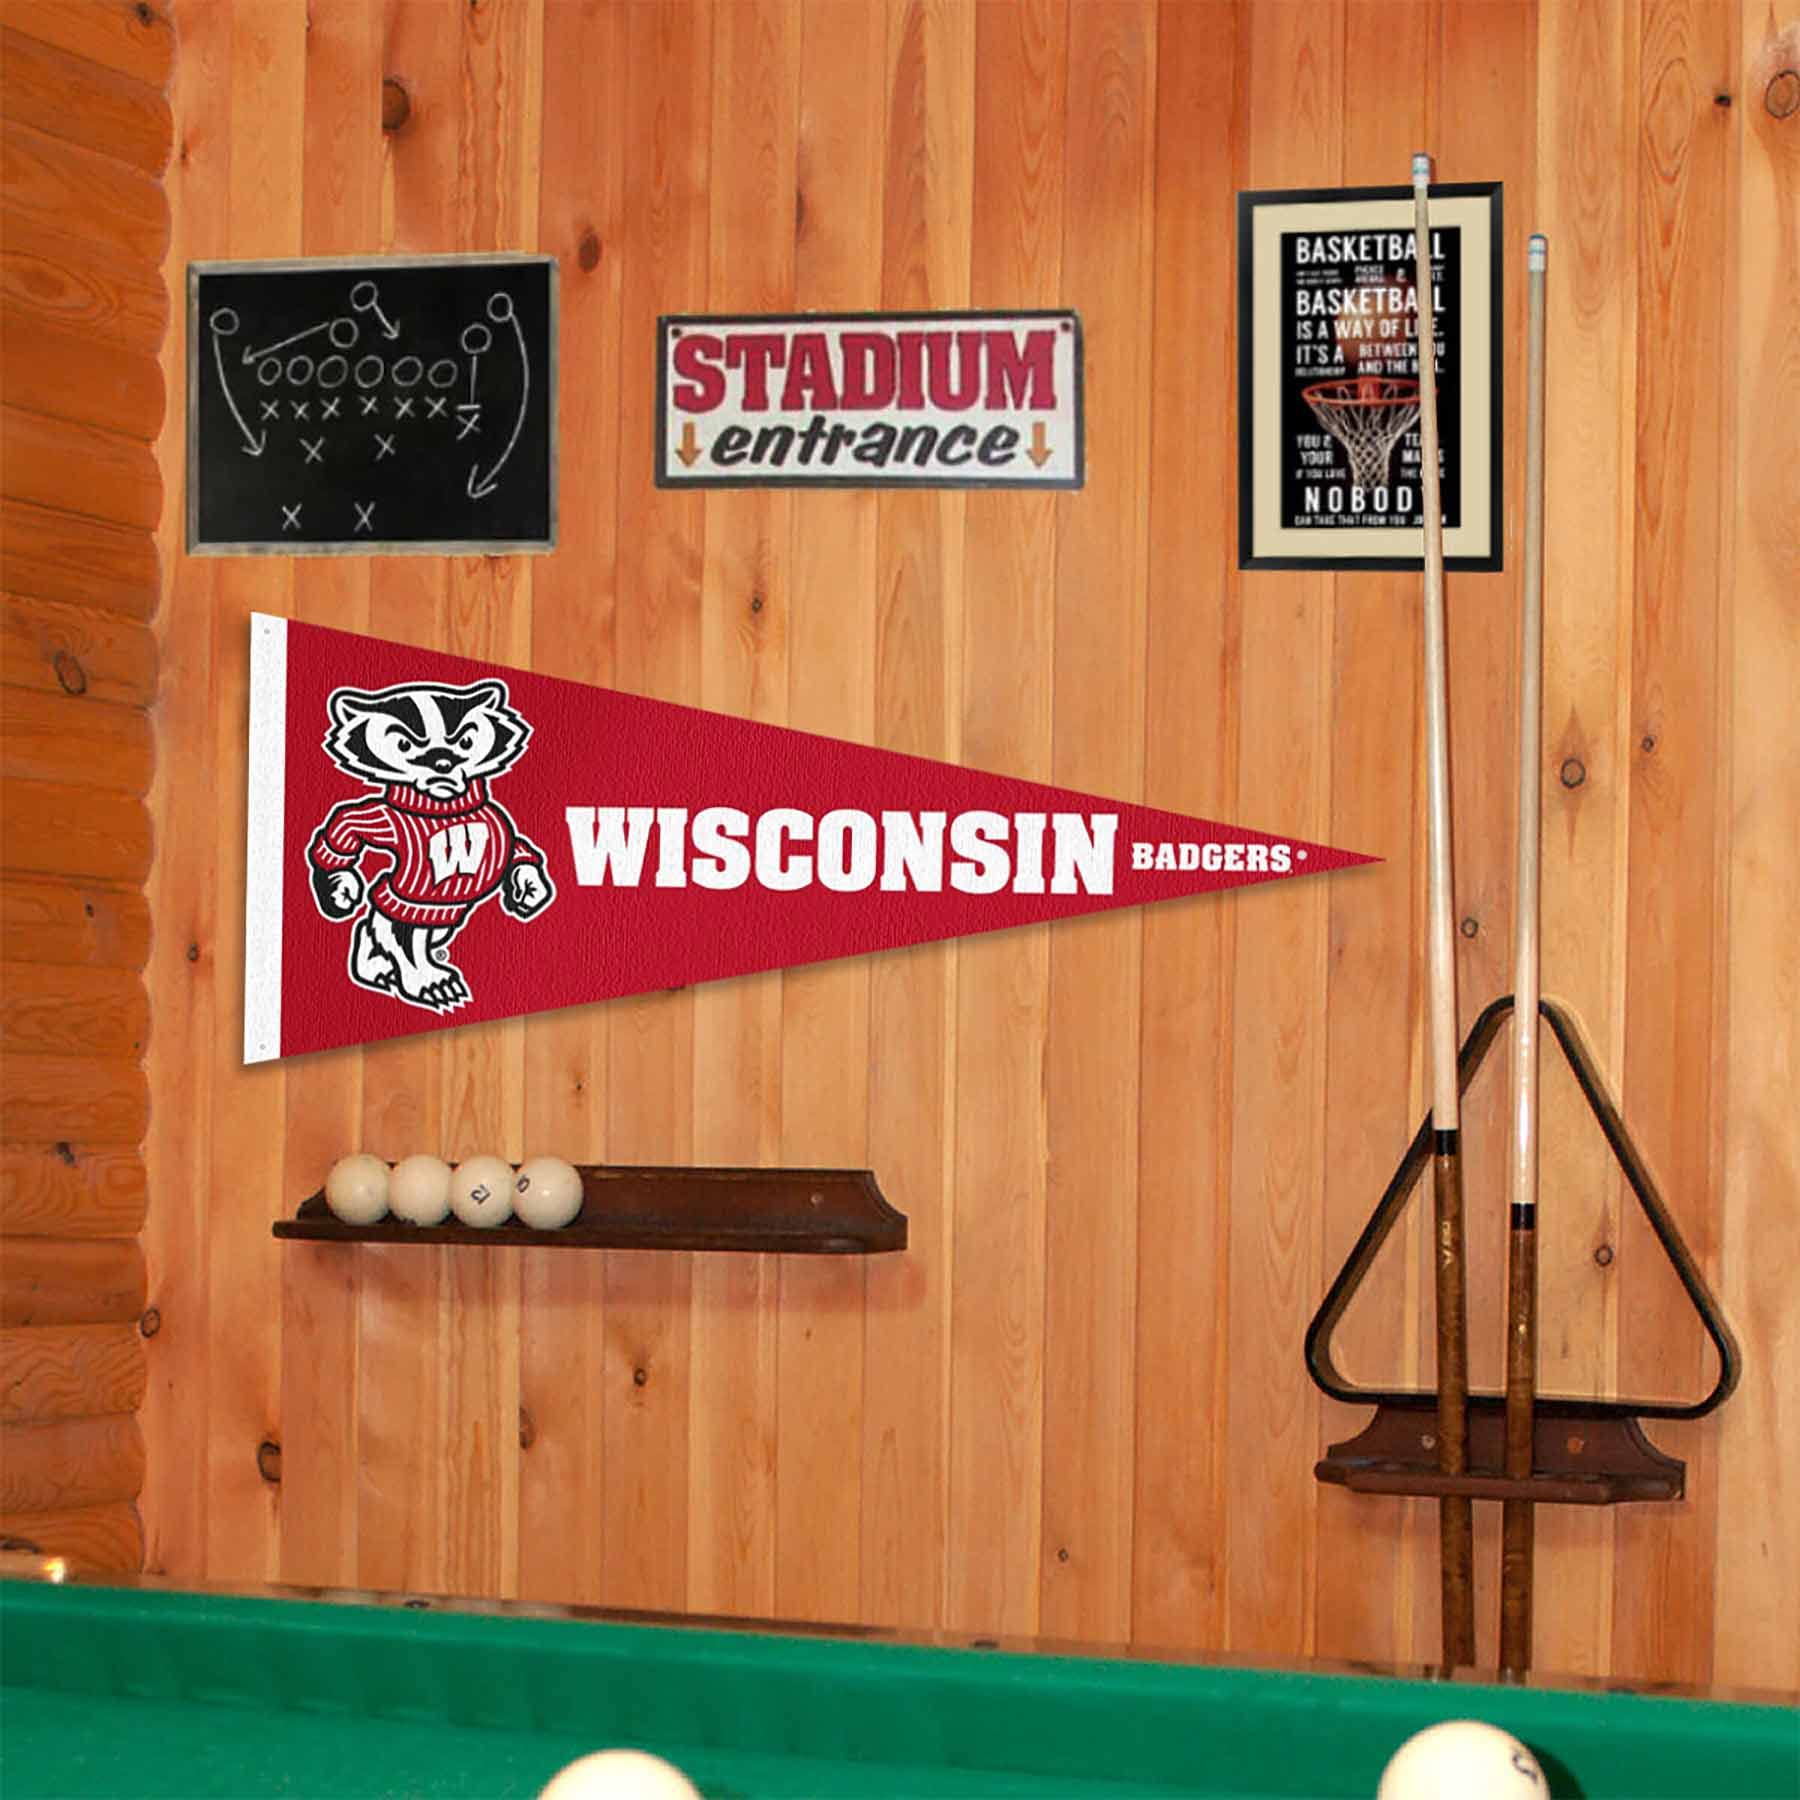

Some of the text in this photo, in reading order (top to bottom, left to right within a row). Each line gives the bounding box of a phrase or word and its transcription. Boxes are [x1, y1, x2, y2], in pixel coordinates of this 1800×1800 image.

[1296, 233, 1446, 264] BASKETBAL
[1296, 286, 1446, 316] BASKETBAL
[1296, 317, 1445, 340] IS A WAY OF LIE.
[1296, 344, 1345, 365] IT'S A
[1357, 359, 1383, 374] AND
[1387, 359, 1409, 374] THE
[672, 330, 1058, 413] STADIUM
[711, 415, 1020, 469] entrance
[1304, 486, 1425, 514] NOBOD
[428, 820, 491, 888] W
[565, 806, 1292, 896] WISCONSIN BADGERS
